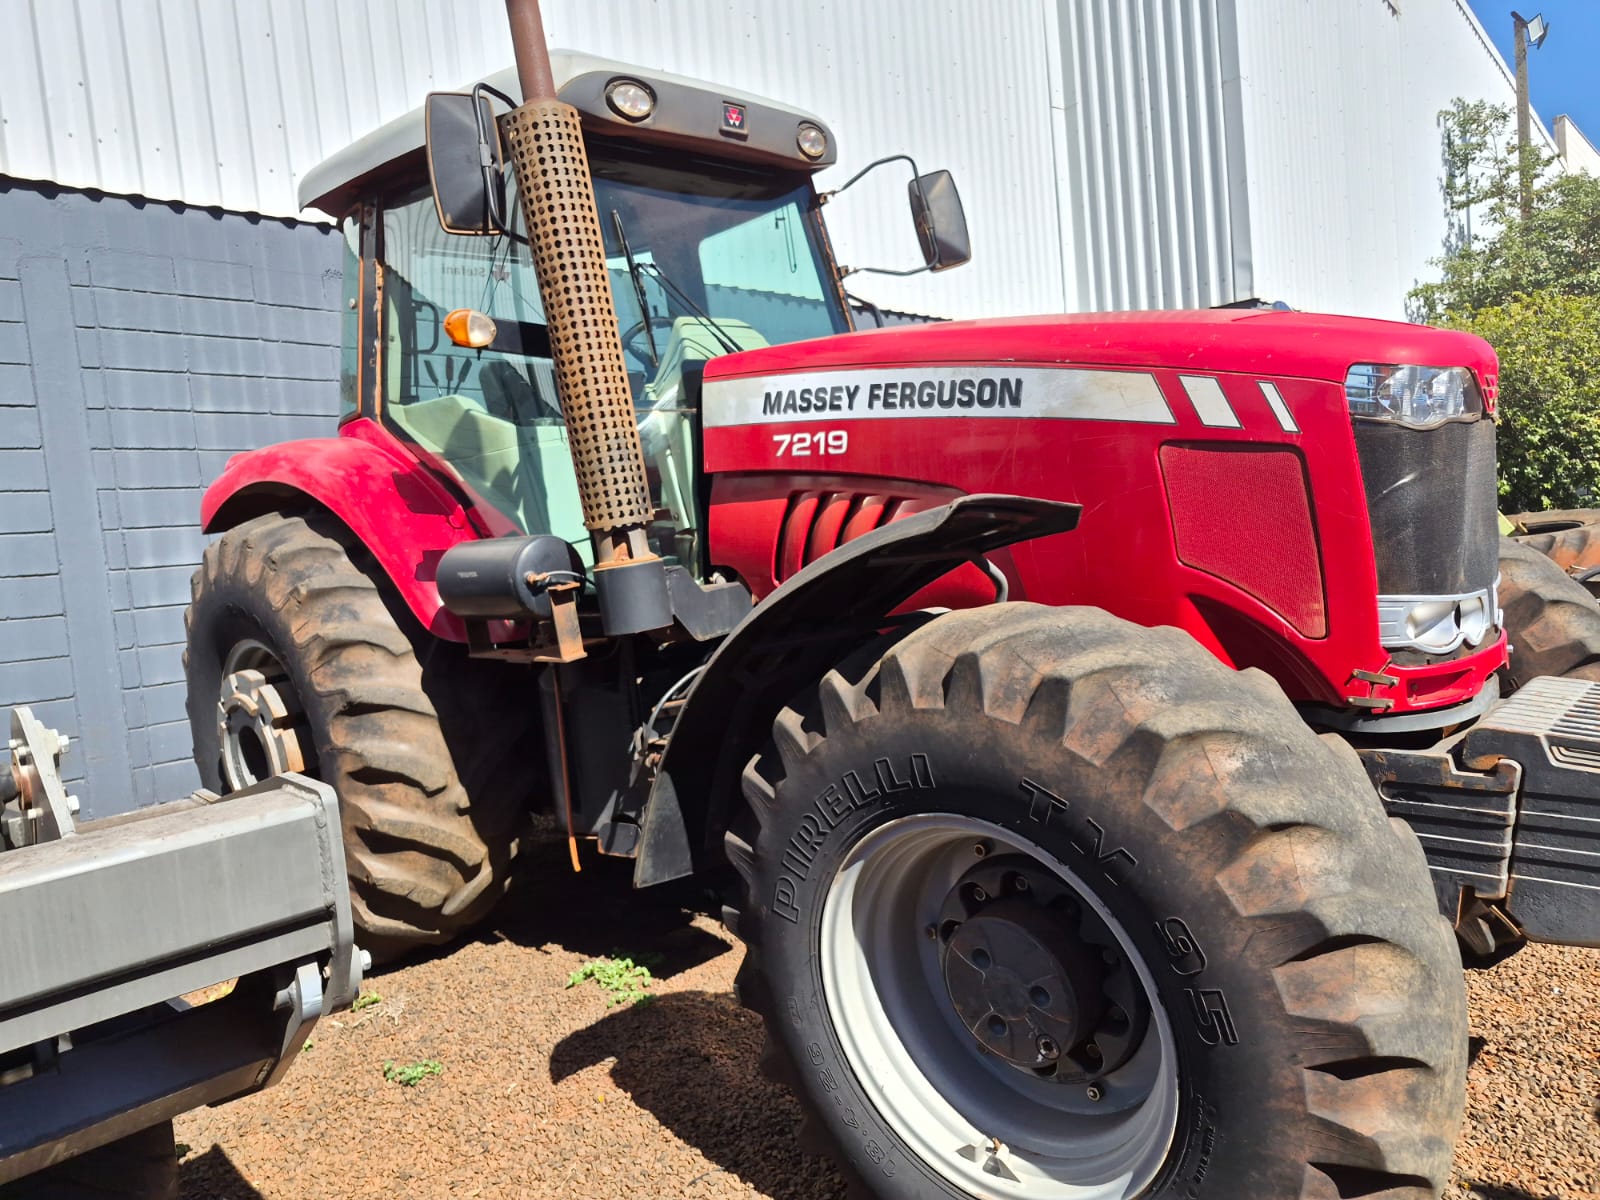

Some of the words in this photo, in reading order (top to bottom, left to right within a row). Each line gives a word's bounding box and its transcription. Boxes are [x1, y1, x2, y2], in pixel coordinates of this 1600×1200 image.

[762, 384, 860, 416] MASSEY
[867, 377, 1023, 410] FERGUSON
[772, 430, 849, 457] 7219
[771, 752, 937, 924] PIRELLI
[1153, 915, 1240, 1047] 95
